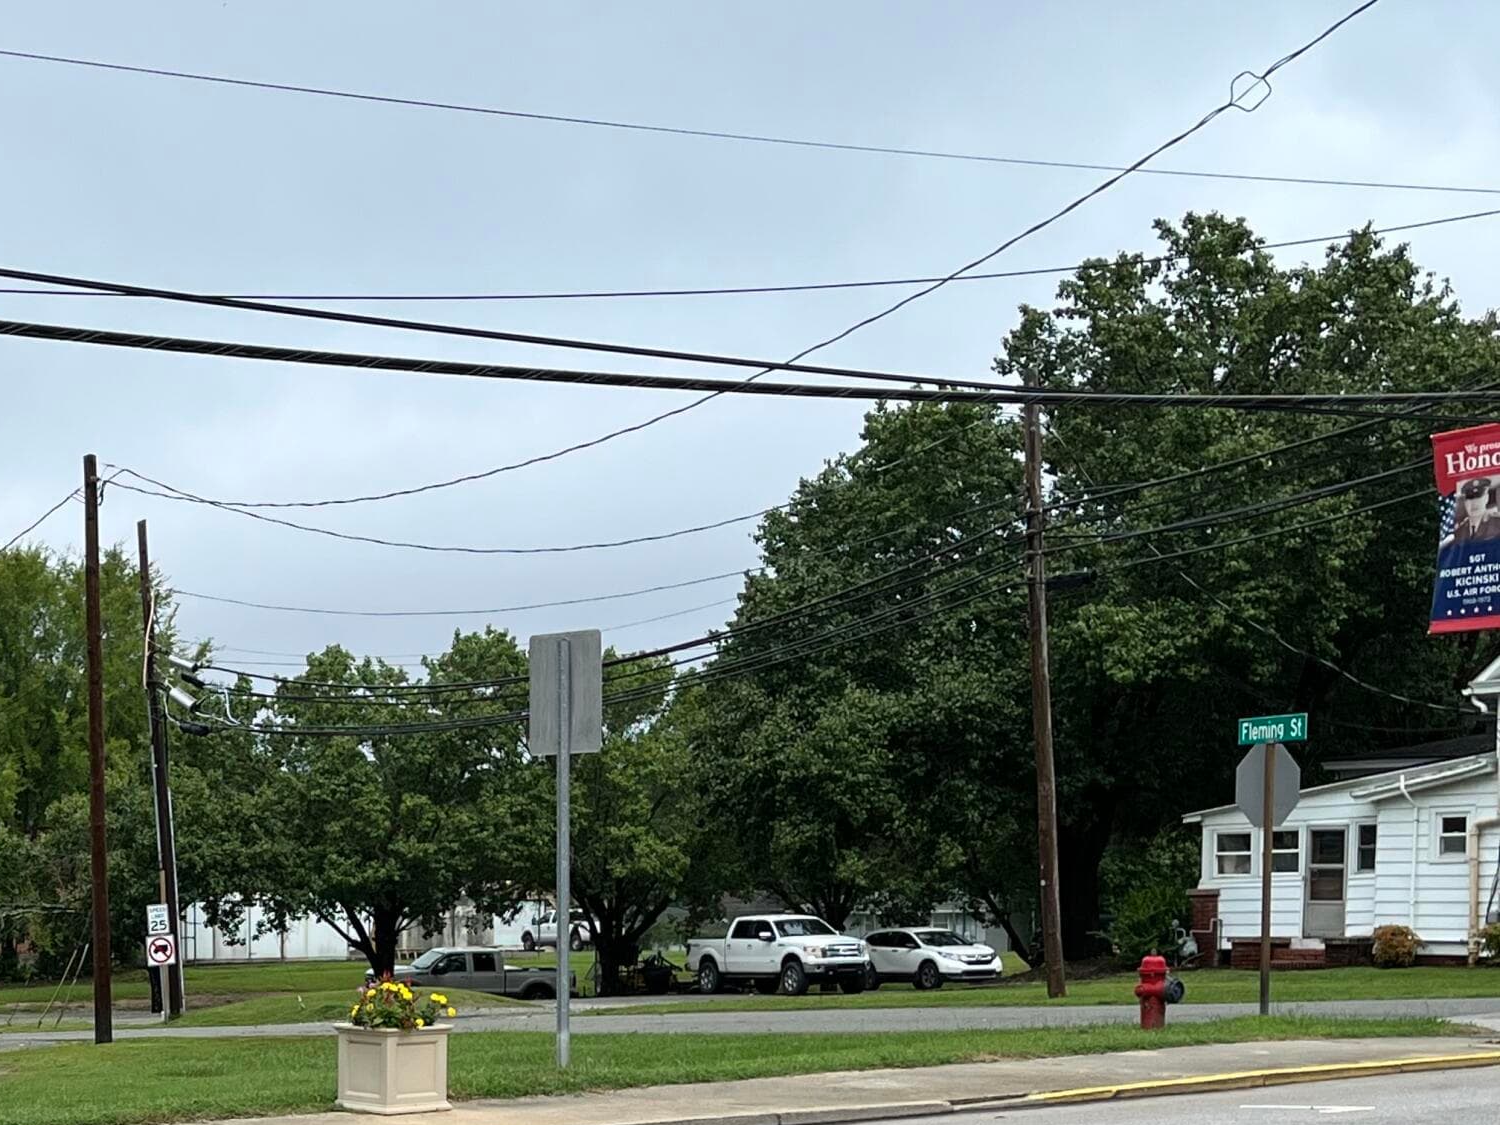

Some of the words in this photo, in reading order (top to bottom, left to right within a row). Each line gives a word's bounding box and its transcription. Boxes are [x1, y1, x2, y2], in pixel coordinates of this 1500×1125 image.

[1469, 553, 1486, 564] SGT
[1439, 566, 1472, 578] ROBERT
[1455, 573, 1499, 587] KICINSKI
[1463, 587, 1478, 596] AIR
[1242, 721, 1284, 741] Fleming
[1290, 718, 1302, 737] St
[150, 920, 167, 931] 25
